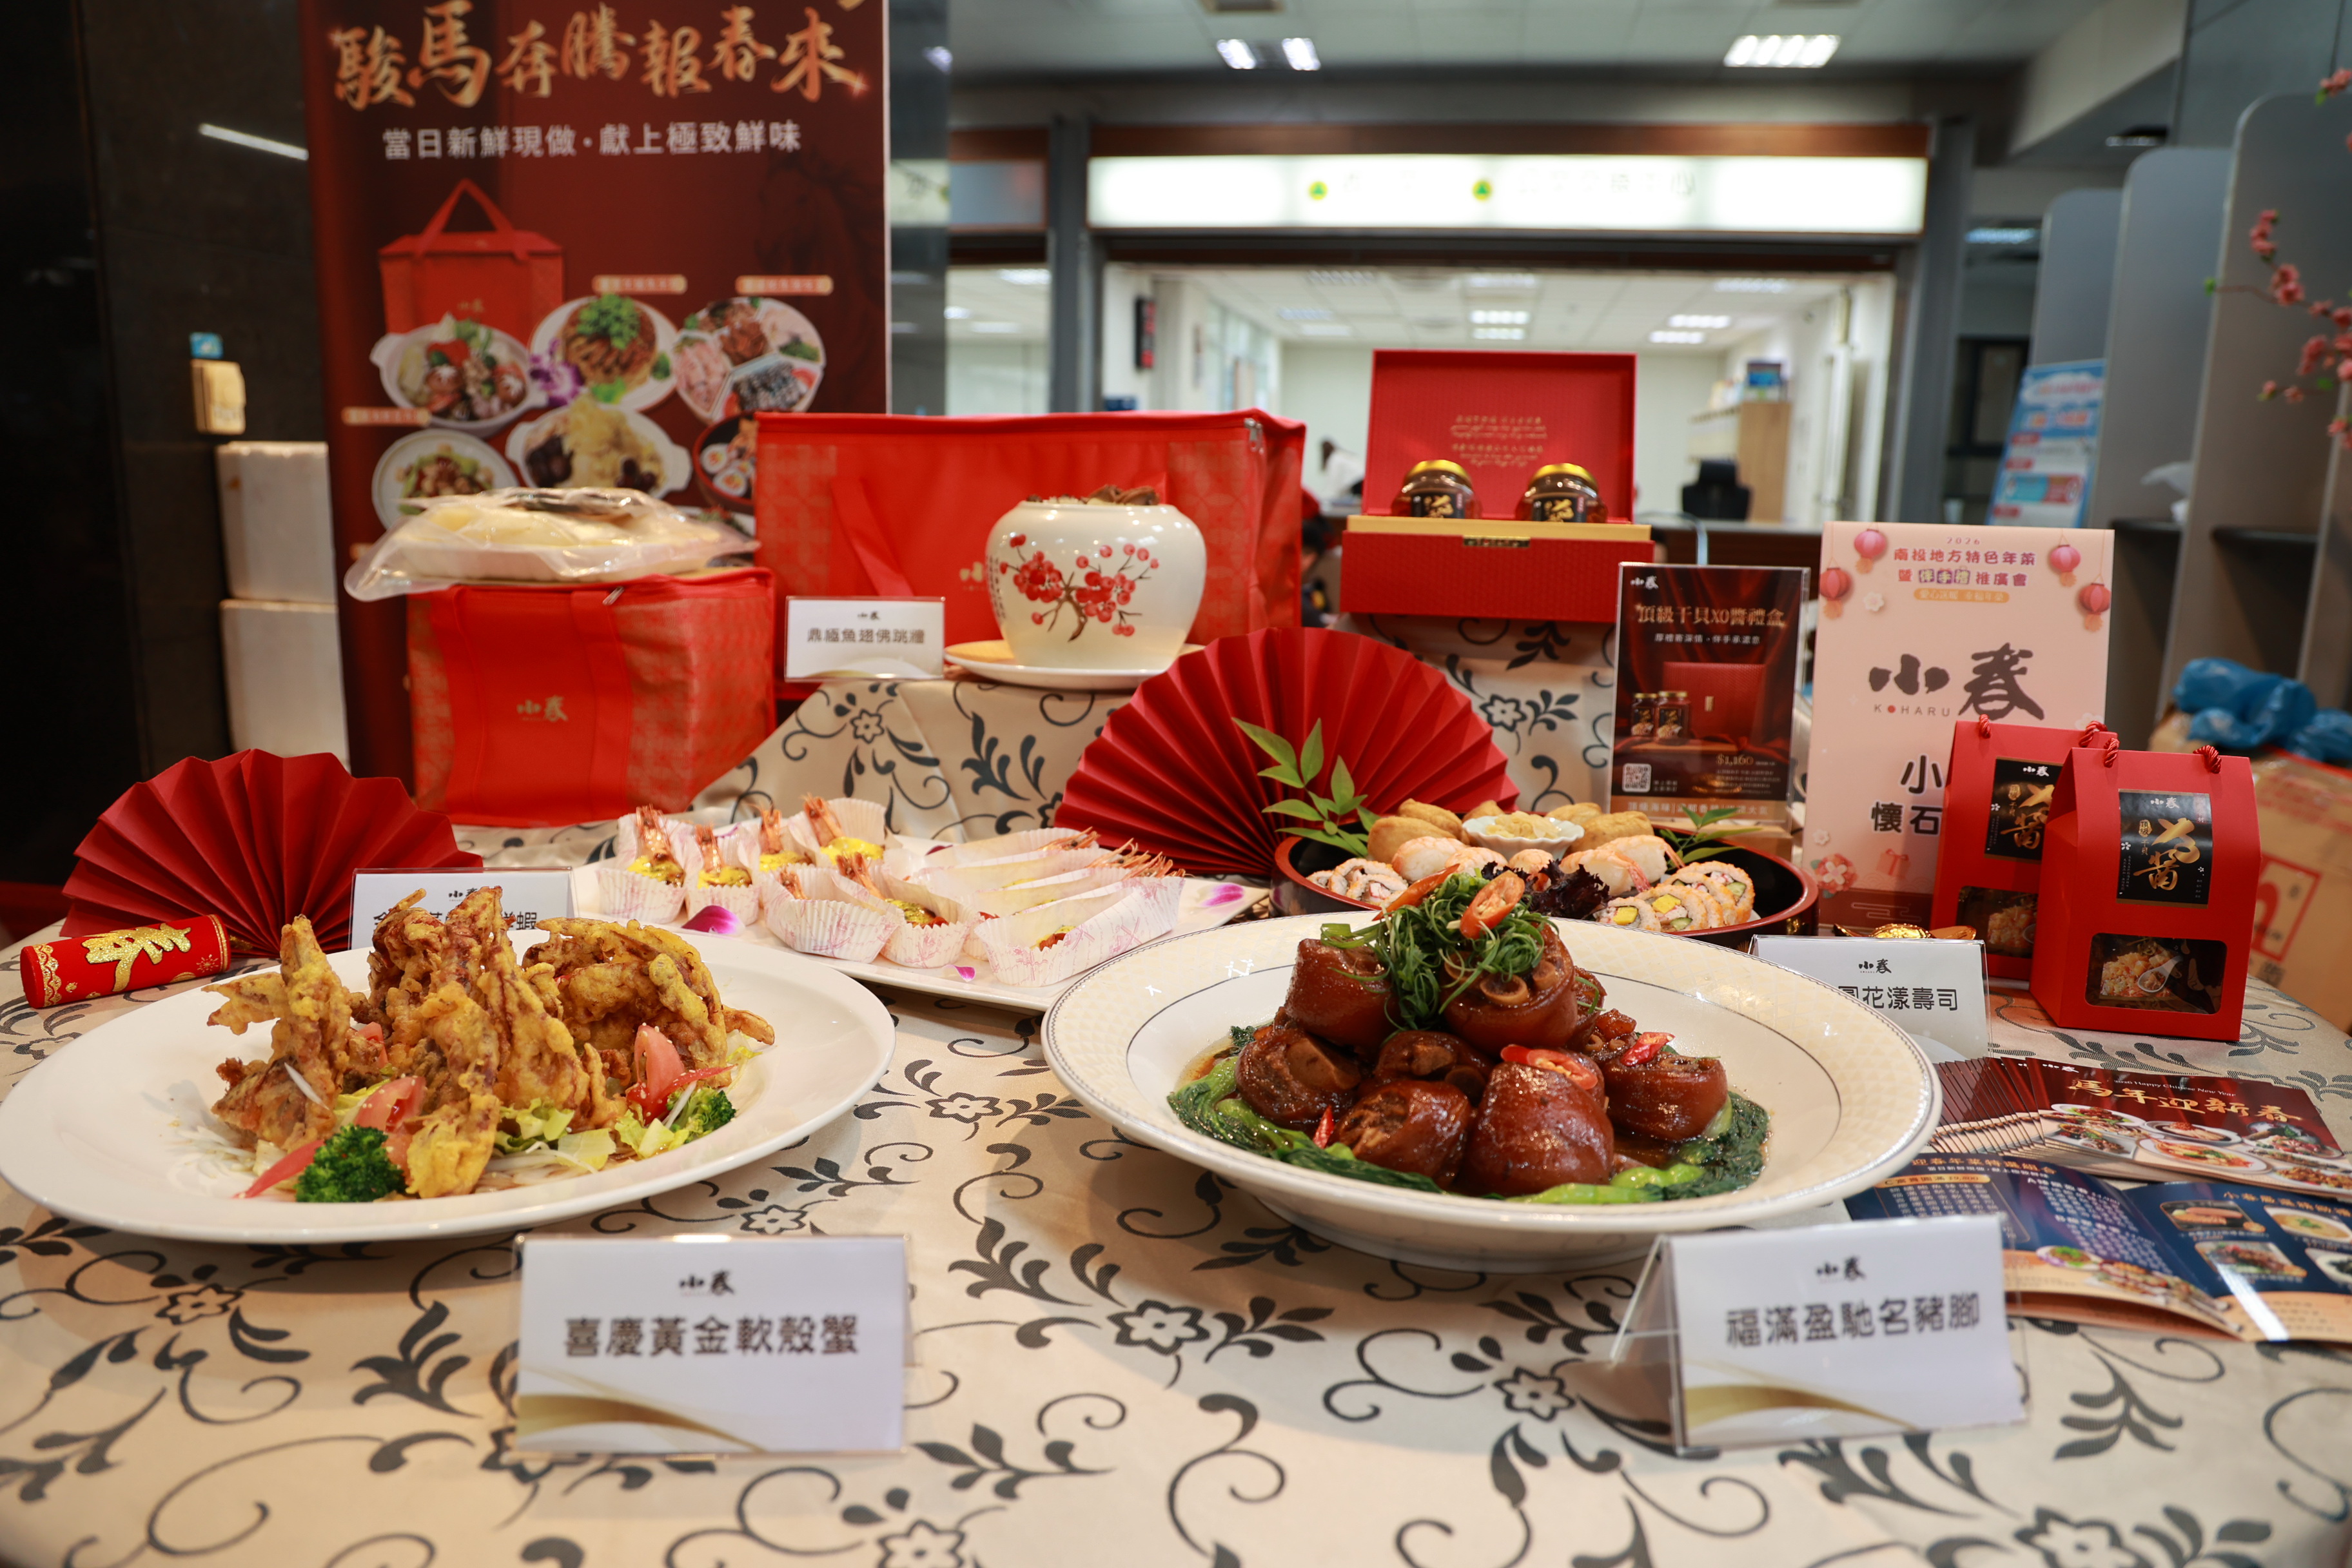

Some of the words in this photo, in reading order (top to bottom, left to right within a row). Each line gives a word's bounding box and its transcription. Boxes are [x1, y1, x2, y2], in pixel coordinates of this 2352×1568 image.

[334, 0, 859, 110] 駿馬奔騰報春來
[1947, 536, 1980, 545] 2026
[1894, 548, 2036, 565] 南投地方特色年菜
[1630, 576, 1659, 589] 小春
[1636, 603, 1787, 629] 頂級干貝XO醬禮盒
[1869, 642, 2044, 720] 小春
[517, 695, 567, 722] 小春
[1716, 753, 1754, 766] $1,160
[2023, 766, 2050, 777] 小春
[2150, 797, 2180, 808] 小春
[1858, 959, 1892, 974] 小春
[2162, 1083, 2196, 1092] Chinese
[2068, 1079, 2302, 1122] 馬年迎新春
[1816, 1255, 1867, 1282] 小春
[679, 1270, 734, 1295] 小春
[1725, 1292, 1980, 1348] 福滿盈馳名豬腳
[564, 1315, 859, 1358] 喜慶黃金軟殼蟹
